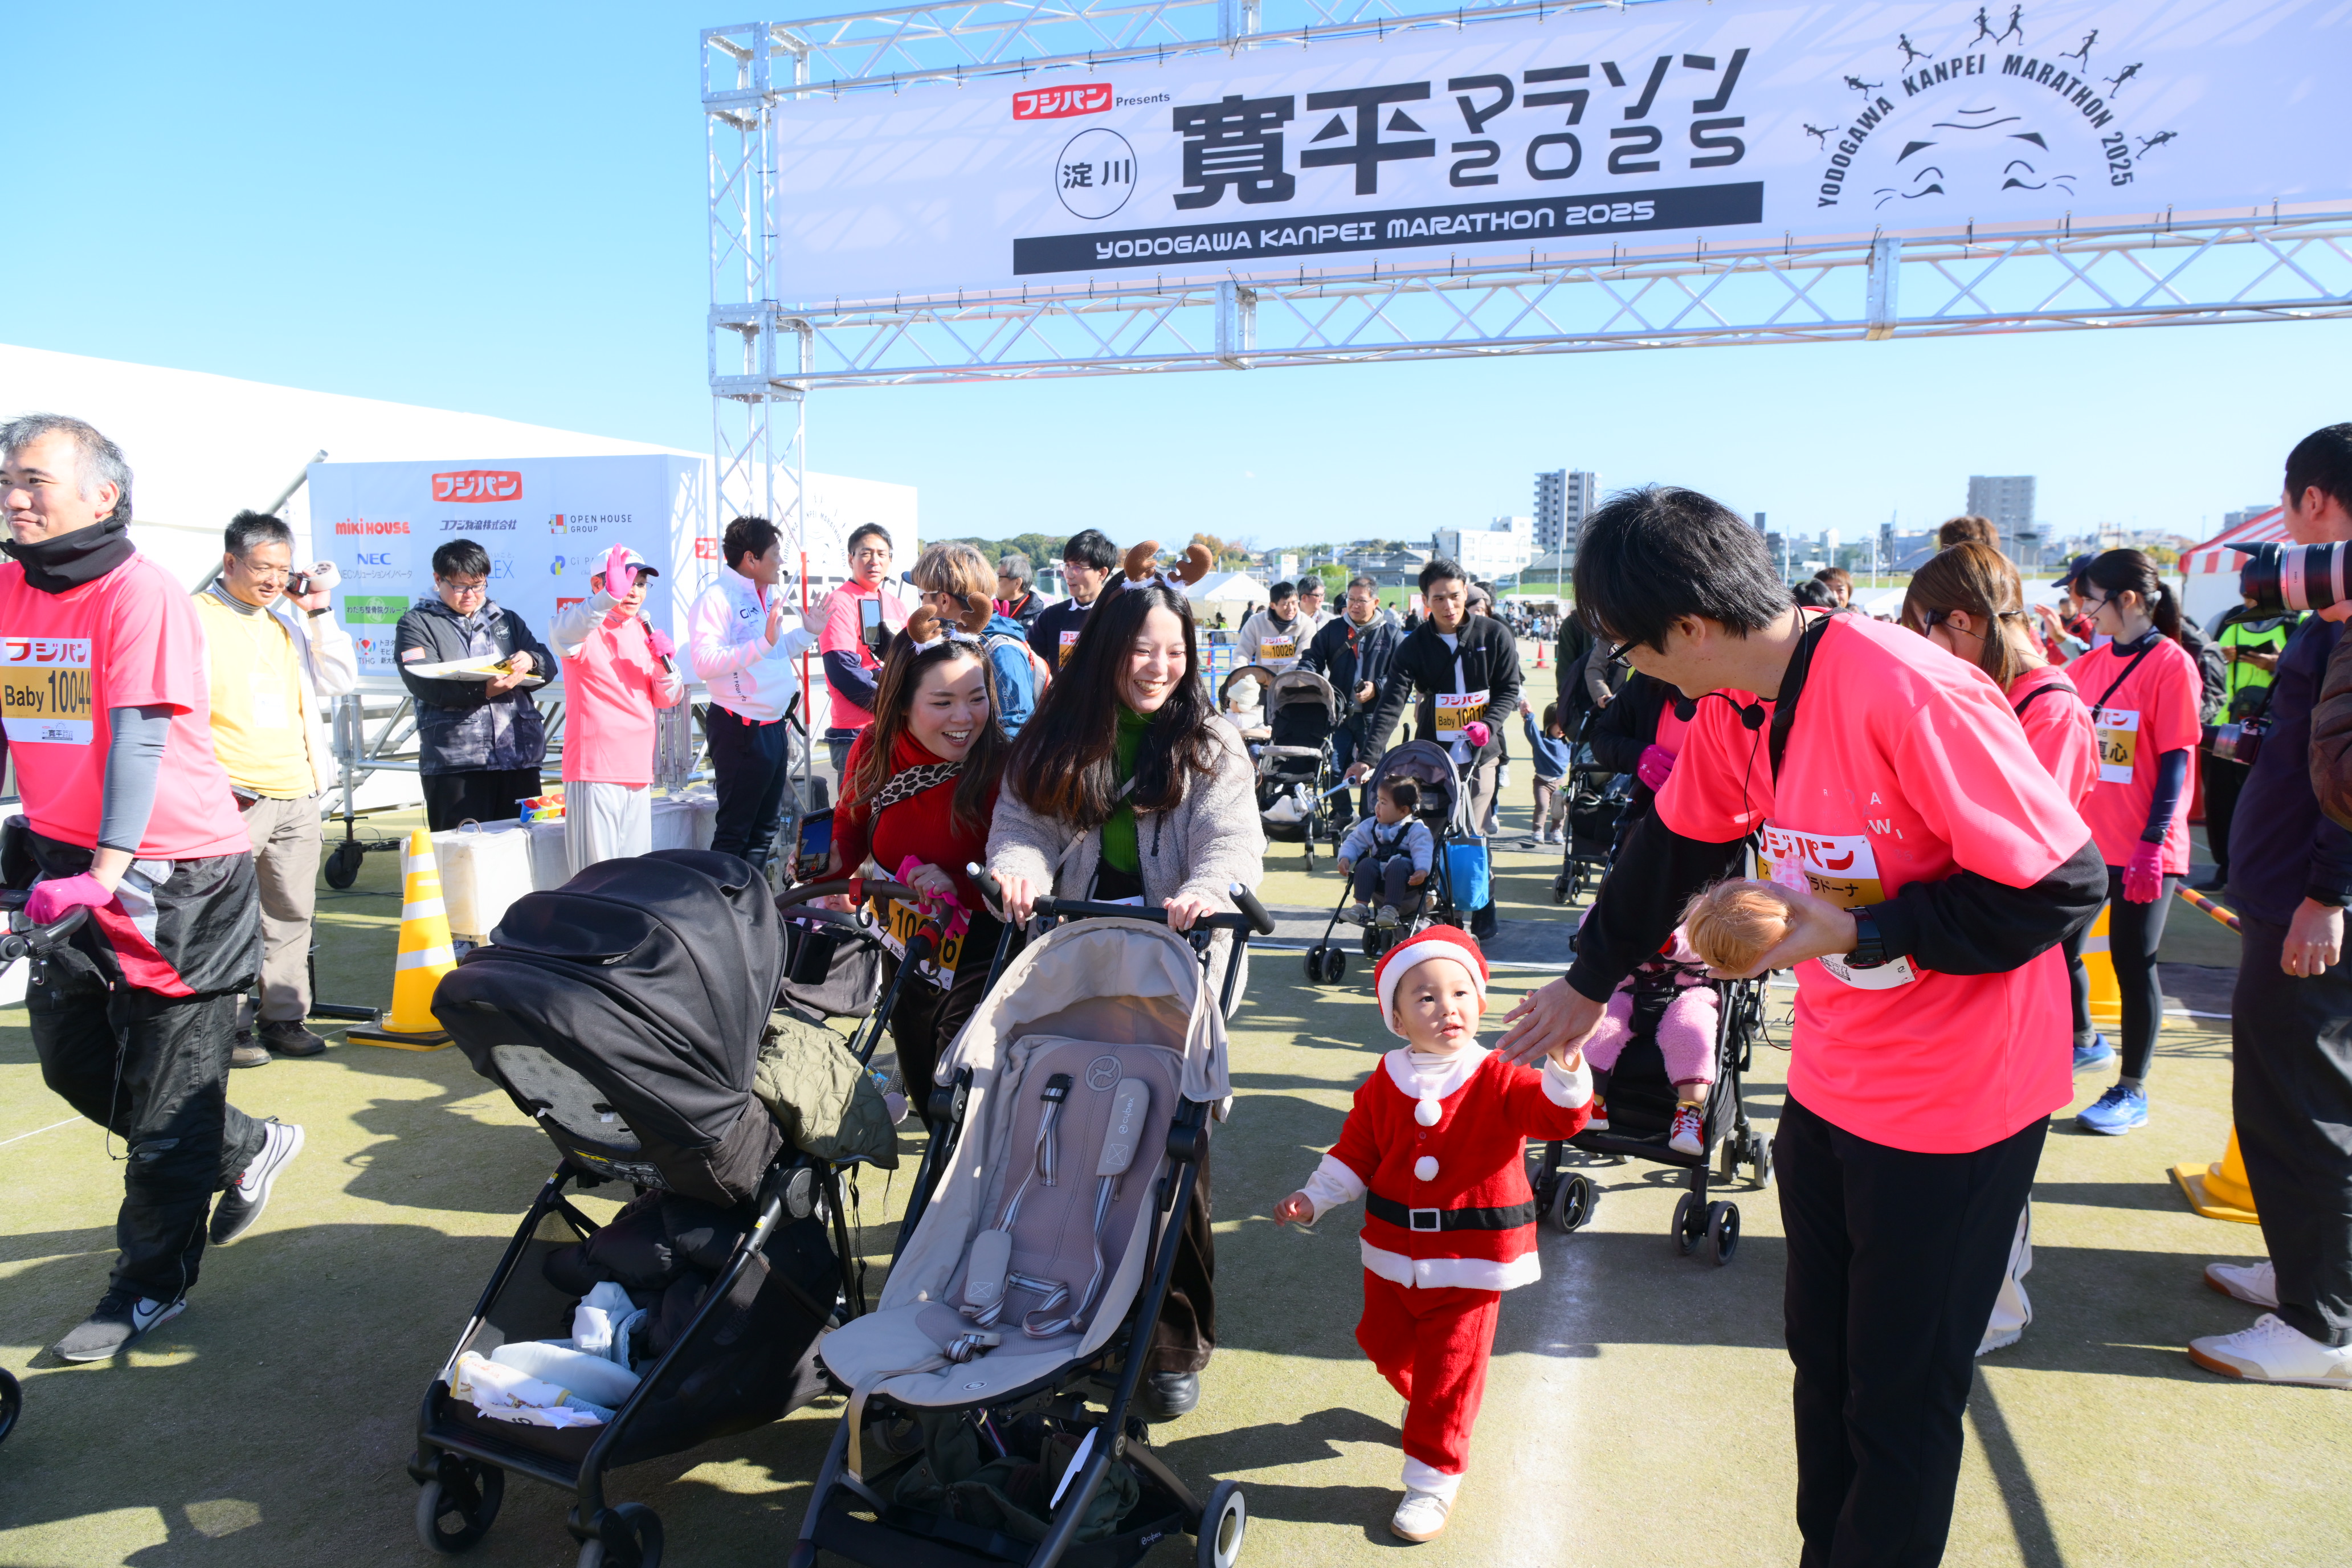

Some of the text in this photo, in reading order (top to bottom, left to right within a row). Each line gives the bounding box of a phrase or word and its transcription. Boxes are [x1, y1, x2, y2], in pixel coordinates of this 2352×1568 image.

[1017, 88, 1170, 116] フジパン Presents
[1818, 54, 2133, 208] YODOGAWA KANPEI MARATHON 2025
[1449, 116, 1746, 187] 2025
[1063, 159, 1130, 189] 淀川
[1096, 200, 1655, 260] YODOGAWA KANPEI MARATHON 2025
[436, 476, 517, 497] フジパン
[366, 522, 410, 534] HOUSE
[439, 520, 517, 530] コフジ物流株式会社
[357, 553, 391, 565] NEC
[347, 606, 408, 614] わだち整骨院グループ
[6, 642, 87, 663] フジパン
[1272, 644, 1293, 657] 10026
[5, 670, 91, 714] Baby 10044
[1441, 695, 1484, 705] フジパン
[1439, 716, 1455, 728] Baby
[1122, 1097, 1134, 1124] cybex
[1146, 1532, 1162, 1542] cybex
